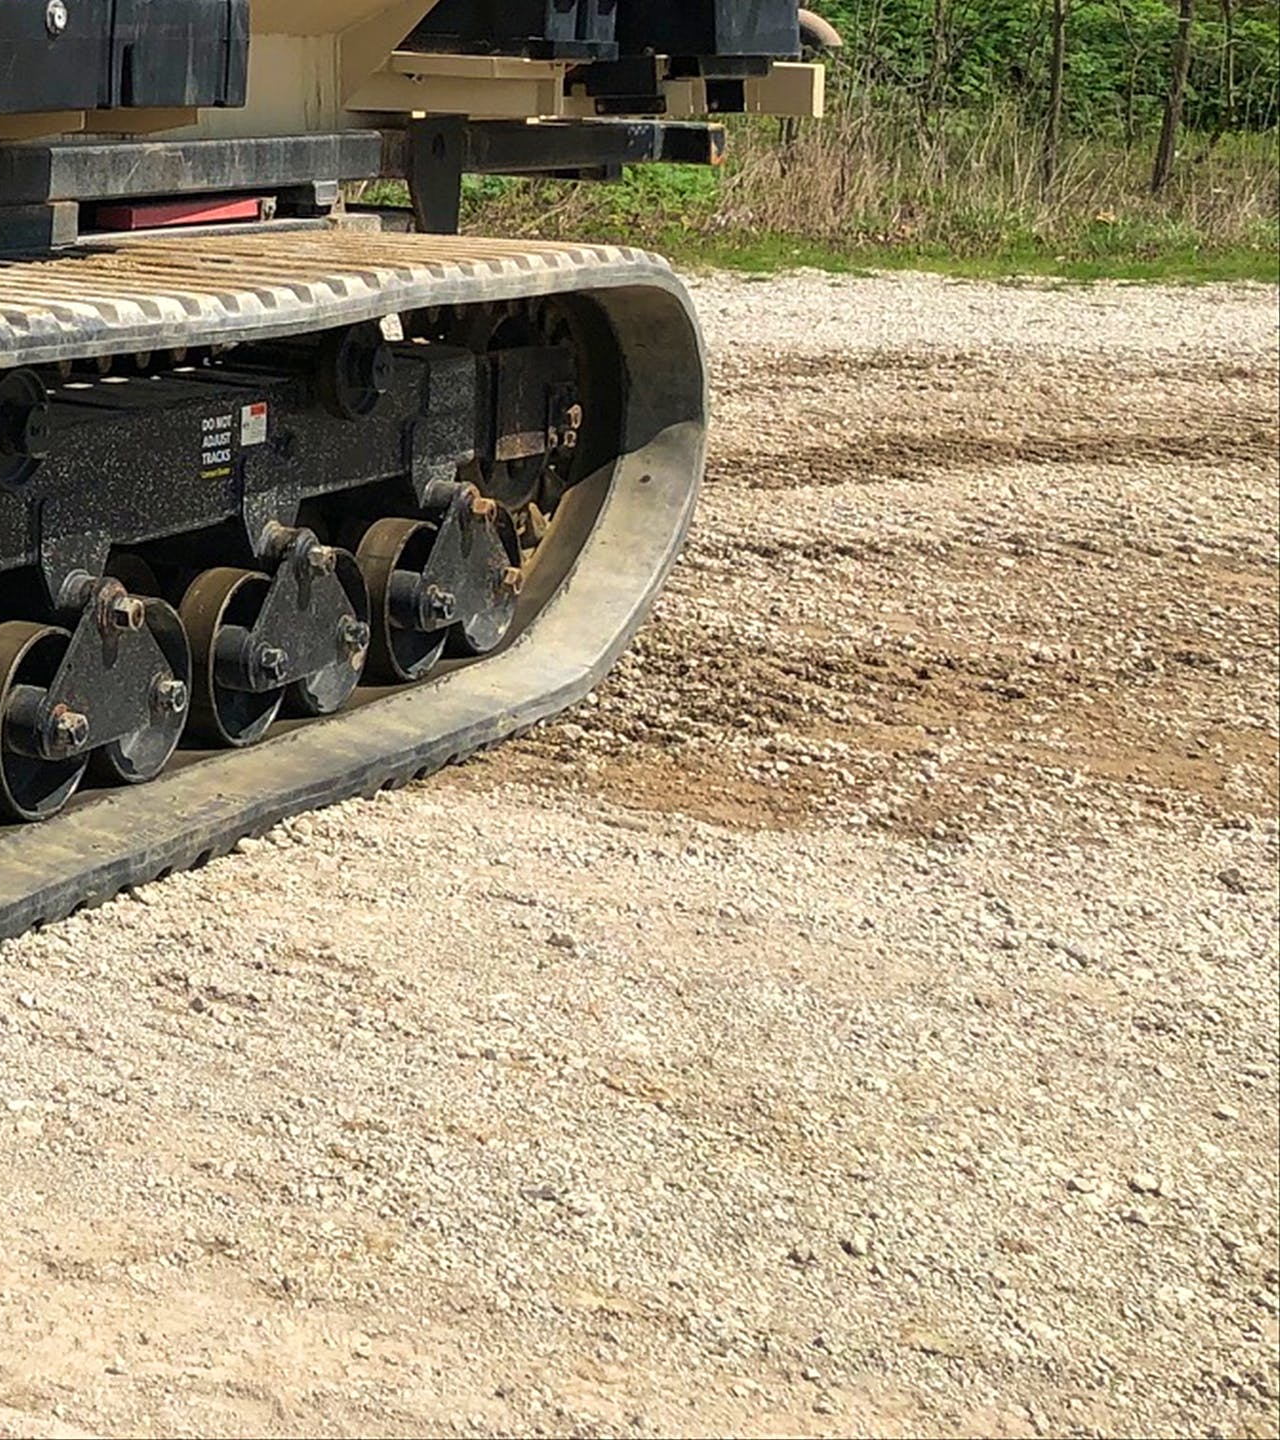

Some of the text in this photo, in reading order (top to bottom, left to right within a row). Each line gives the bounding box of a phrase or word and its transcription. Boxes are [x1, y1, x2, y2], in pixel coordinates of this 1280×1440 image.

[201, 414, 233, 432] DO NOT
[201, 431, 232, 448] ADJUST
[201, 448, 231, 465] TRACKS
